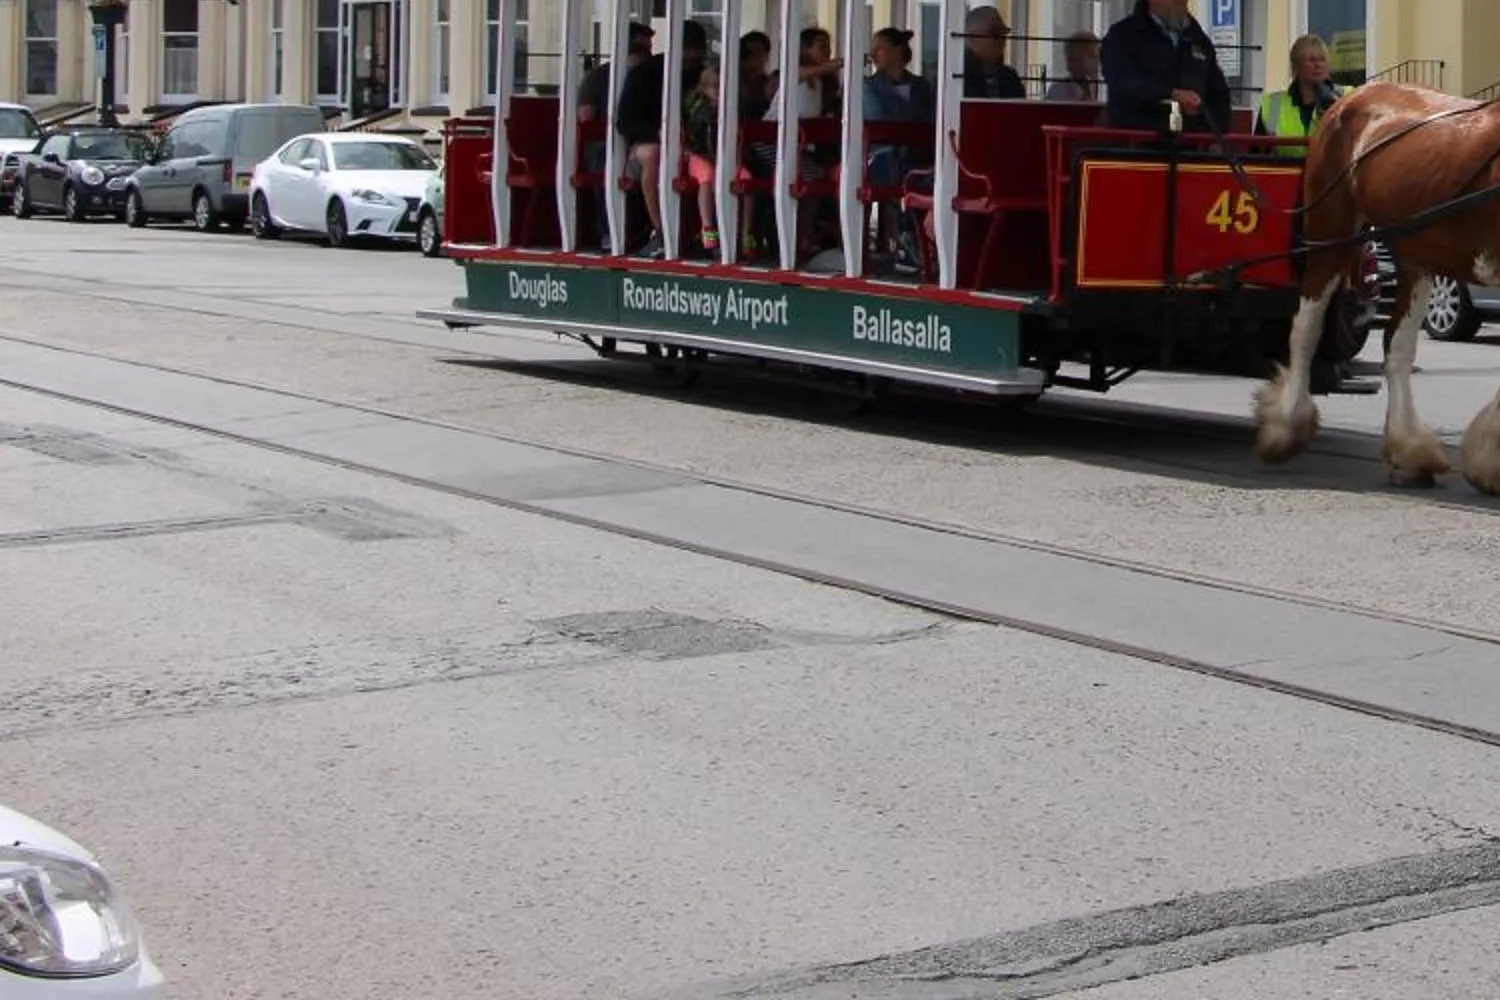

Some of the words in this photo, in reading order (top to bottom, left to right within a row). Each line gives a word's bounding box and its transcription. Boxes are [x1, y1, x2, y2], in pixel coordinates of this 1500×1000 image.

[1206, 190, 1259, 235] 45
[508, 270, 569, 309] Douglas
[622, 277, 721, 326] Ronaldsway
[724, 287, 789, 331] Airport
[852, 304, 952, 353] Ballasalla
